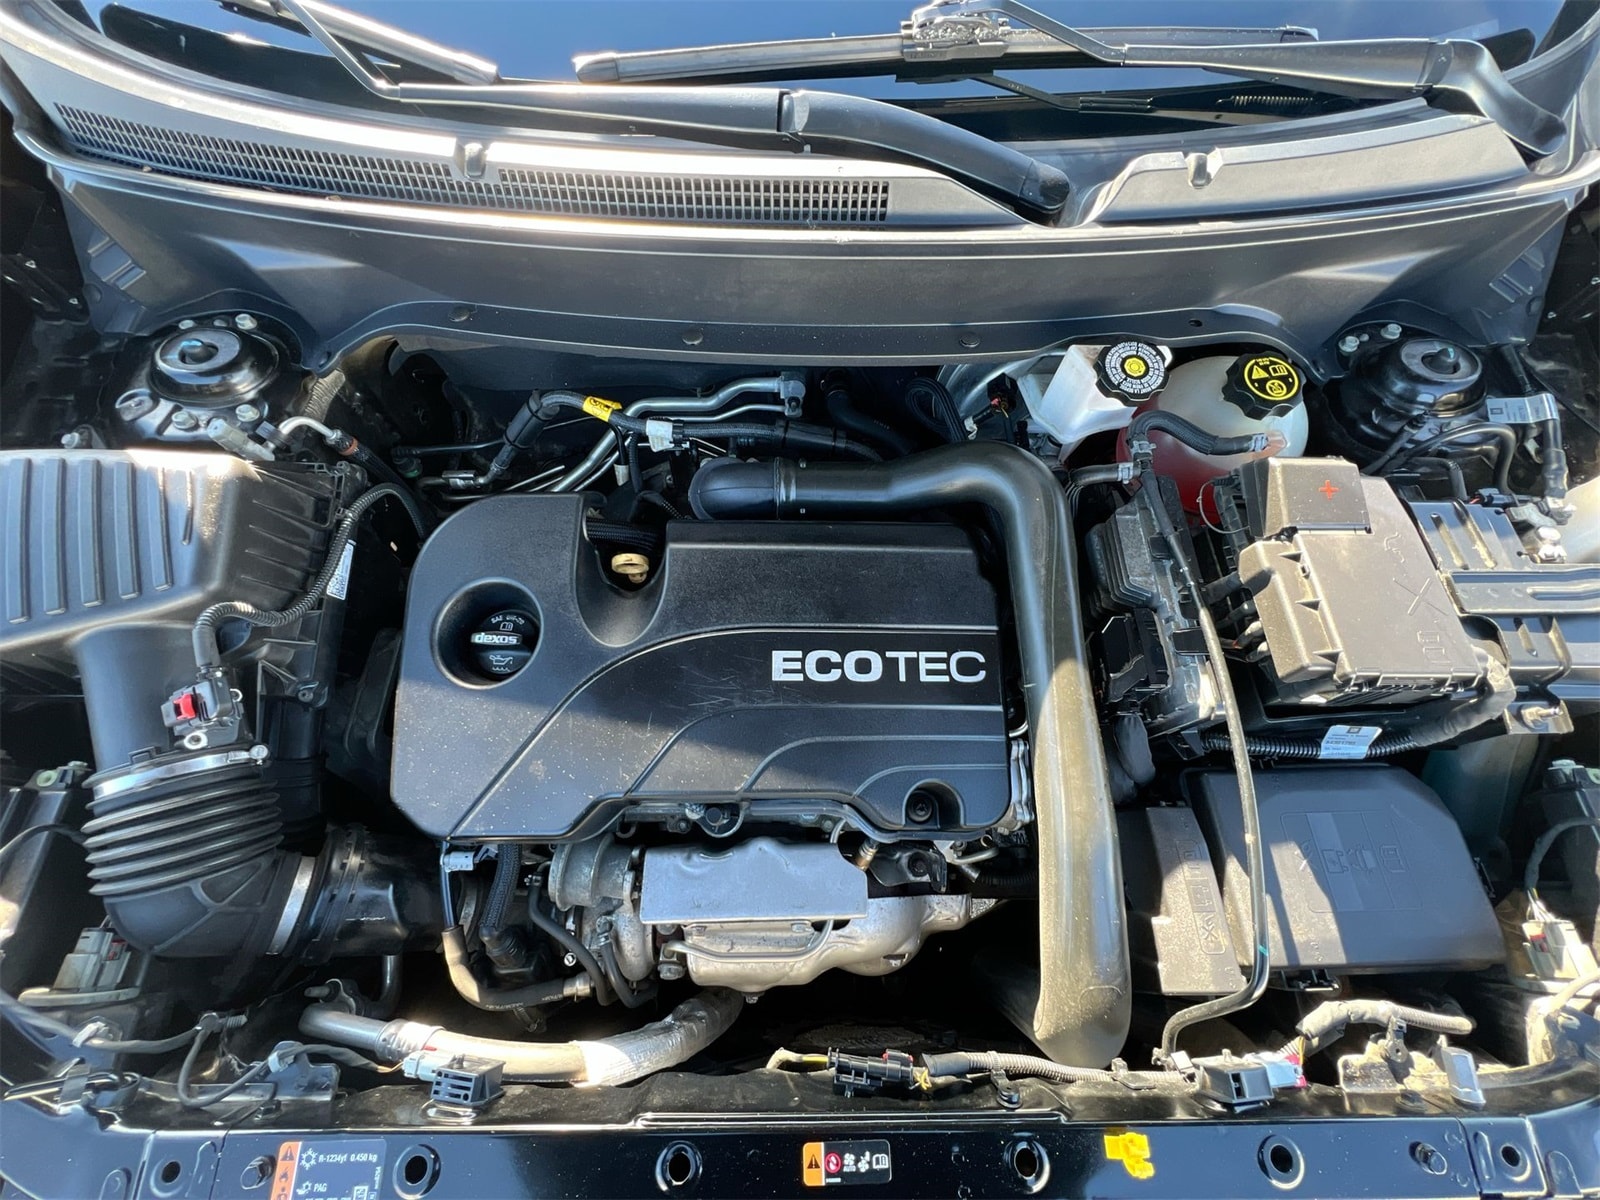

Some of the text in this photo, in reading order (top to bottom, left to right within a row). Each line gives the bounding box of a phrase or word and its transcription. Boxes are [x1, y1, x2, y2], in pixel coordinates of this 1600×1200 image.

[474, 632, 519, 645] dexos
[771, 649, 986, 683] ECOTEC
[350, 1152, 368, 1162] 0.450
[368, 1152, 378, 1163] kg
[313, 1183, 328, 1192] PAG
